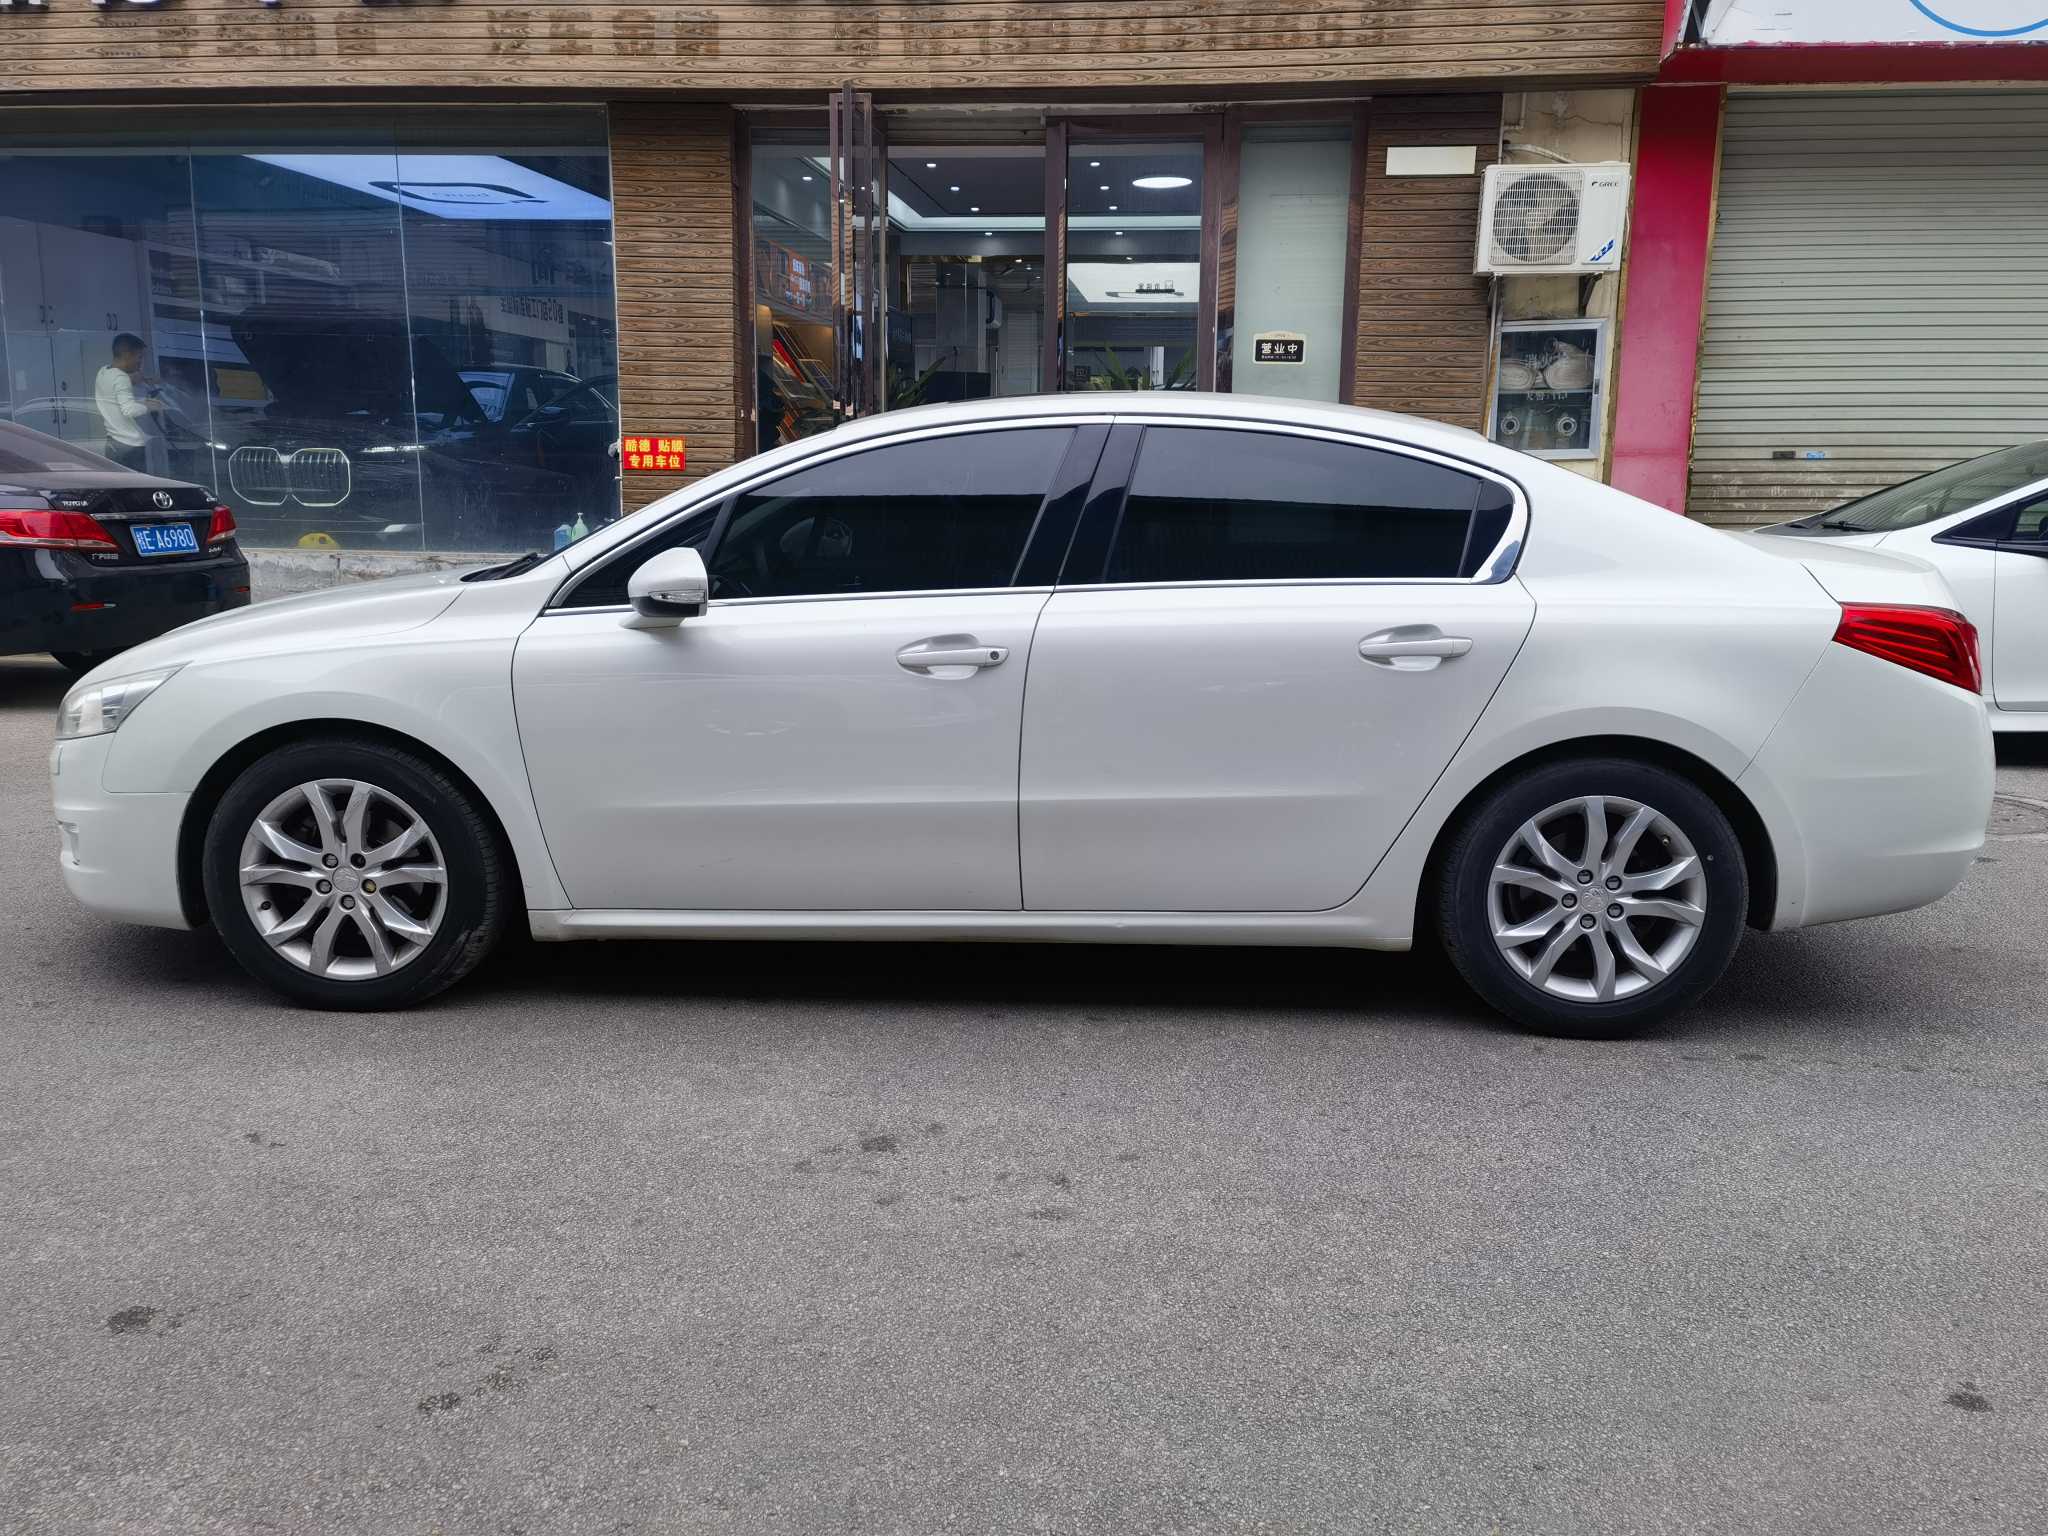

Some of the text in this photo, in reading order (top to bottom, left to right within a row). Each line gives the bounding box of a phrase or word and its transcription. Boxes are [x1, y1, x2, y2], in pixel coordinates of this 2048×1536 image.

[1261, 342, 1298, 354] 营业中
[625, 439, 684, 453] 酷德 贴膜
[628, 454, 681, 468] 专用车位
